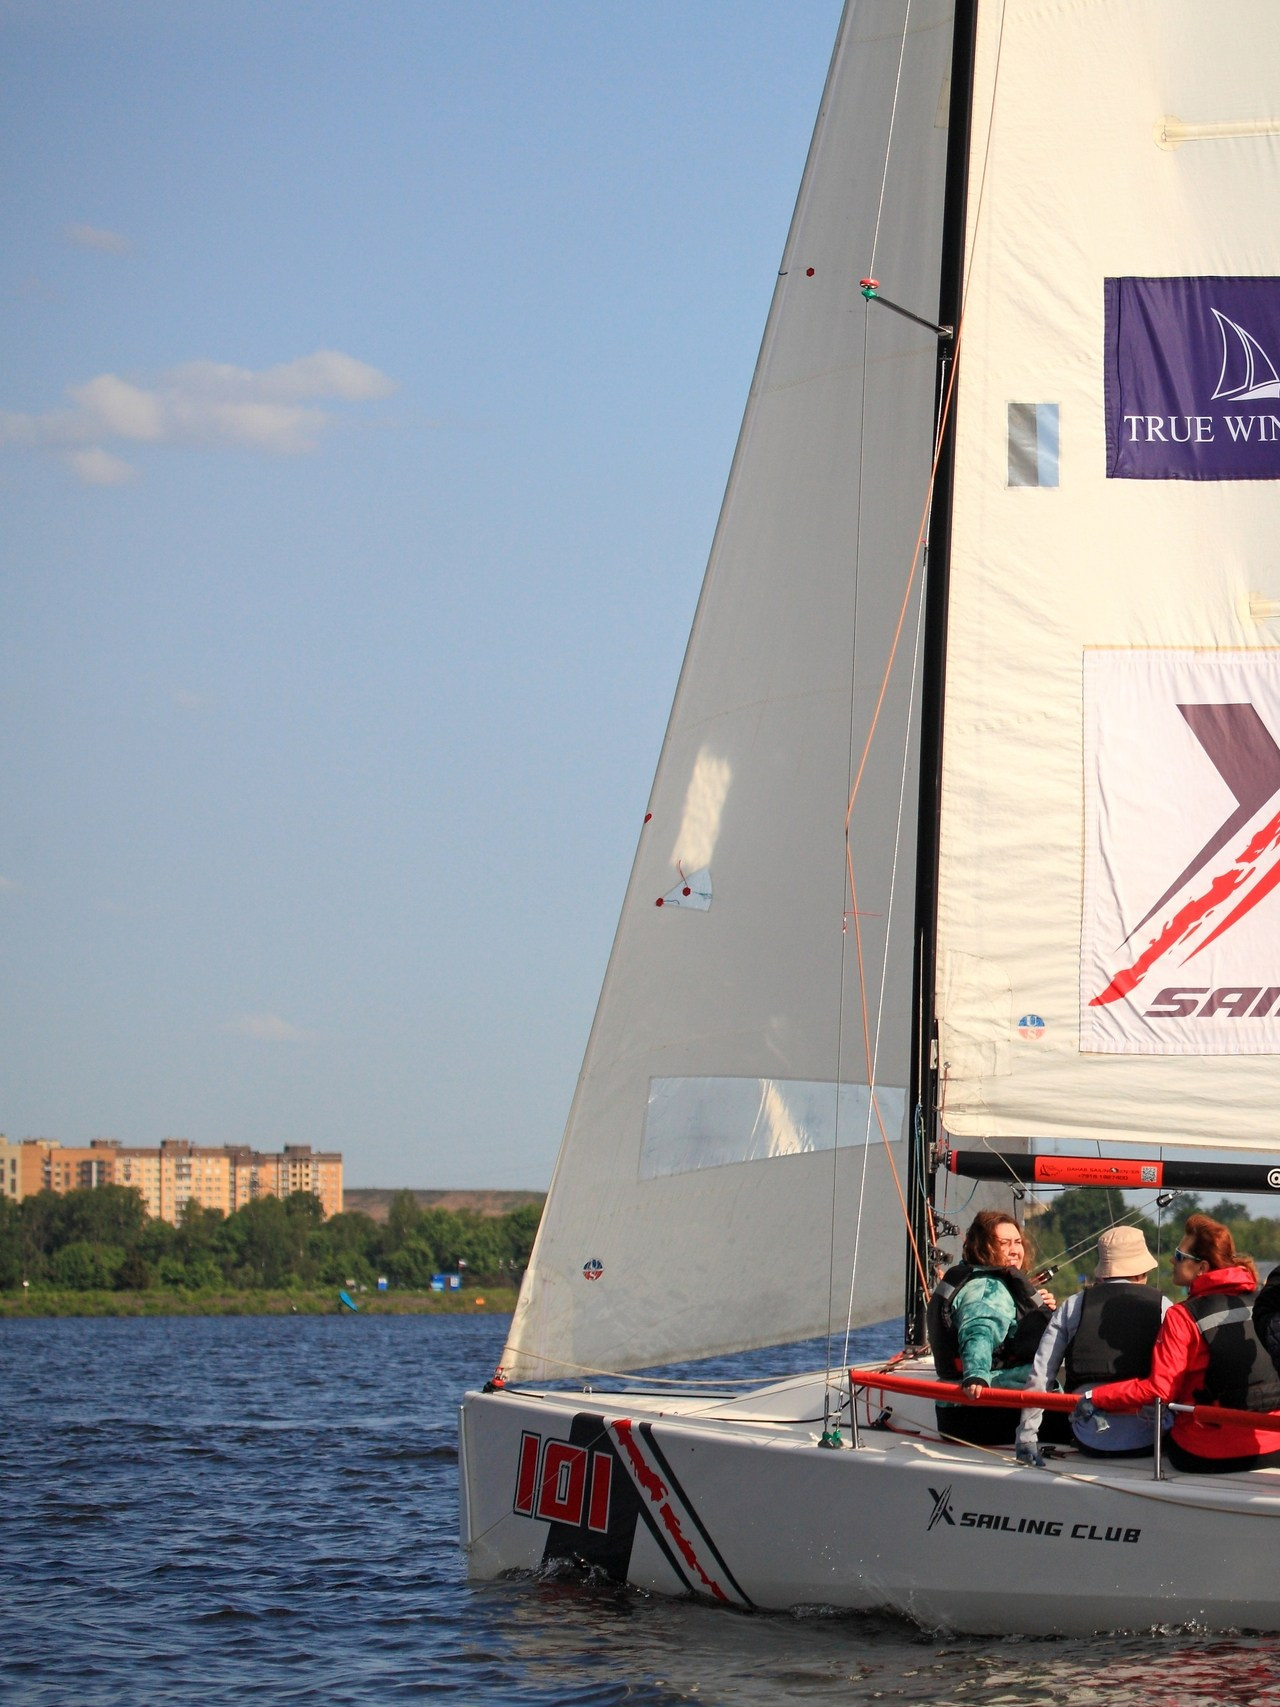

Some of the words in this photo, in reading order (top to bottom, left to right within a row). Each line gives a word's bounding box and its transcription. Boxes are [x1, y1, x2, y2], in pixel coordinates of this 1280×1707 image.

[1124, 414, 1215, 443] TRUE
[513, 1429, 614, 1534] 101
[960, 1512, 1064, 1537] SAILING
[1070, 1524, 1142, 1544] CLUB
